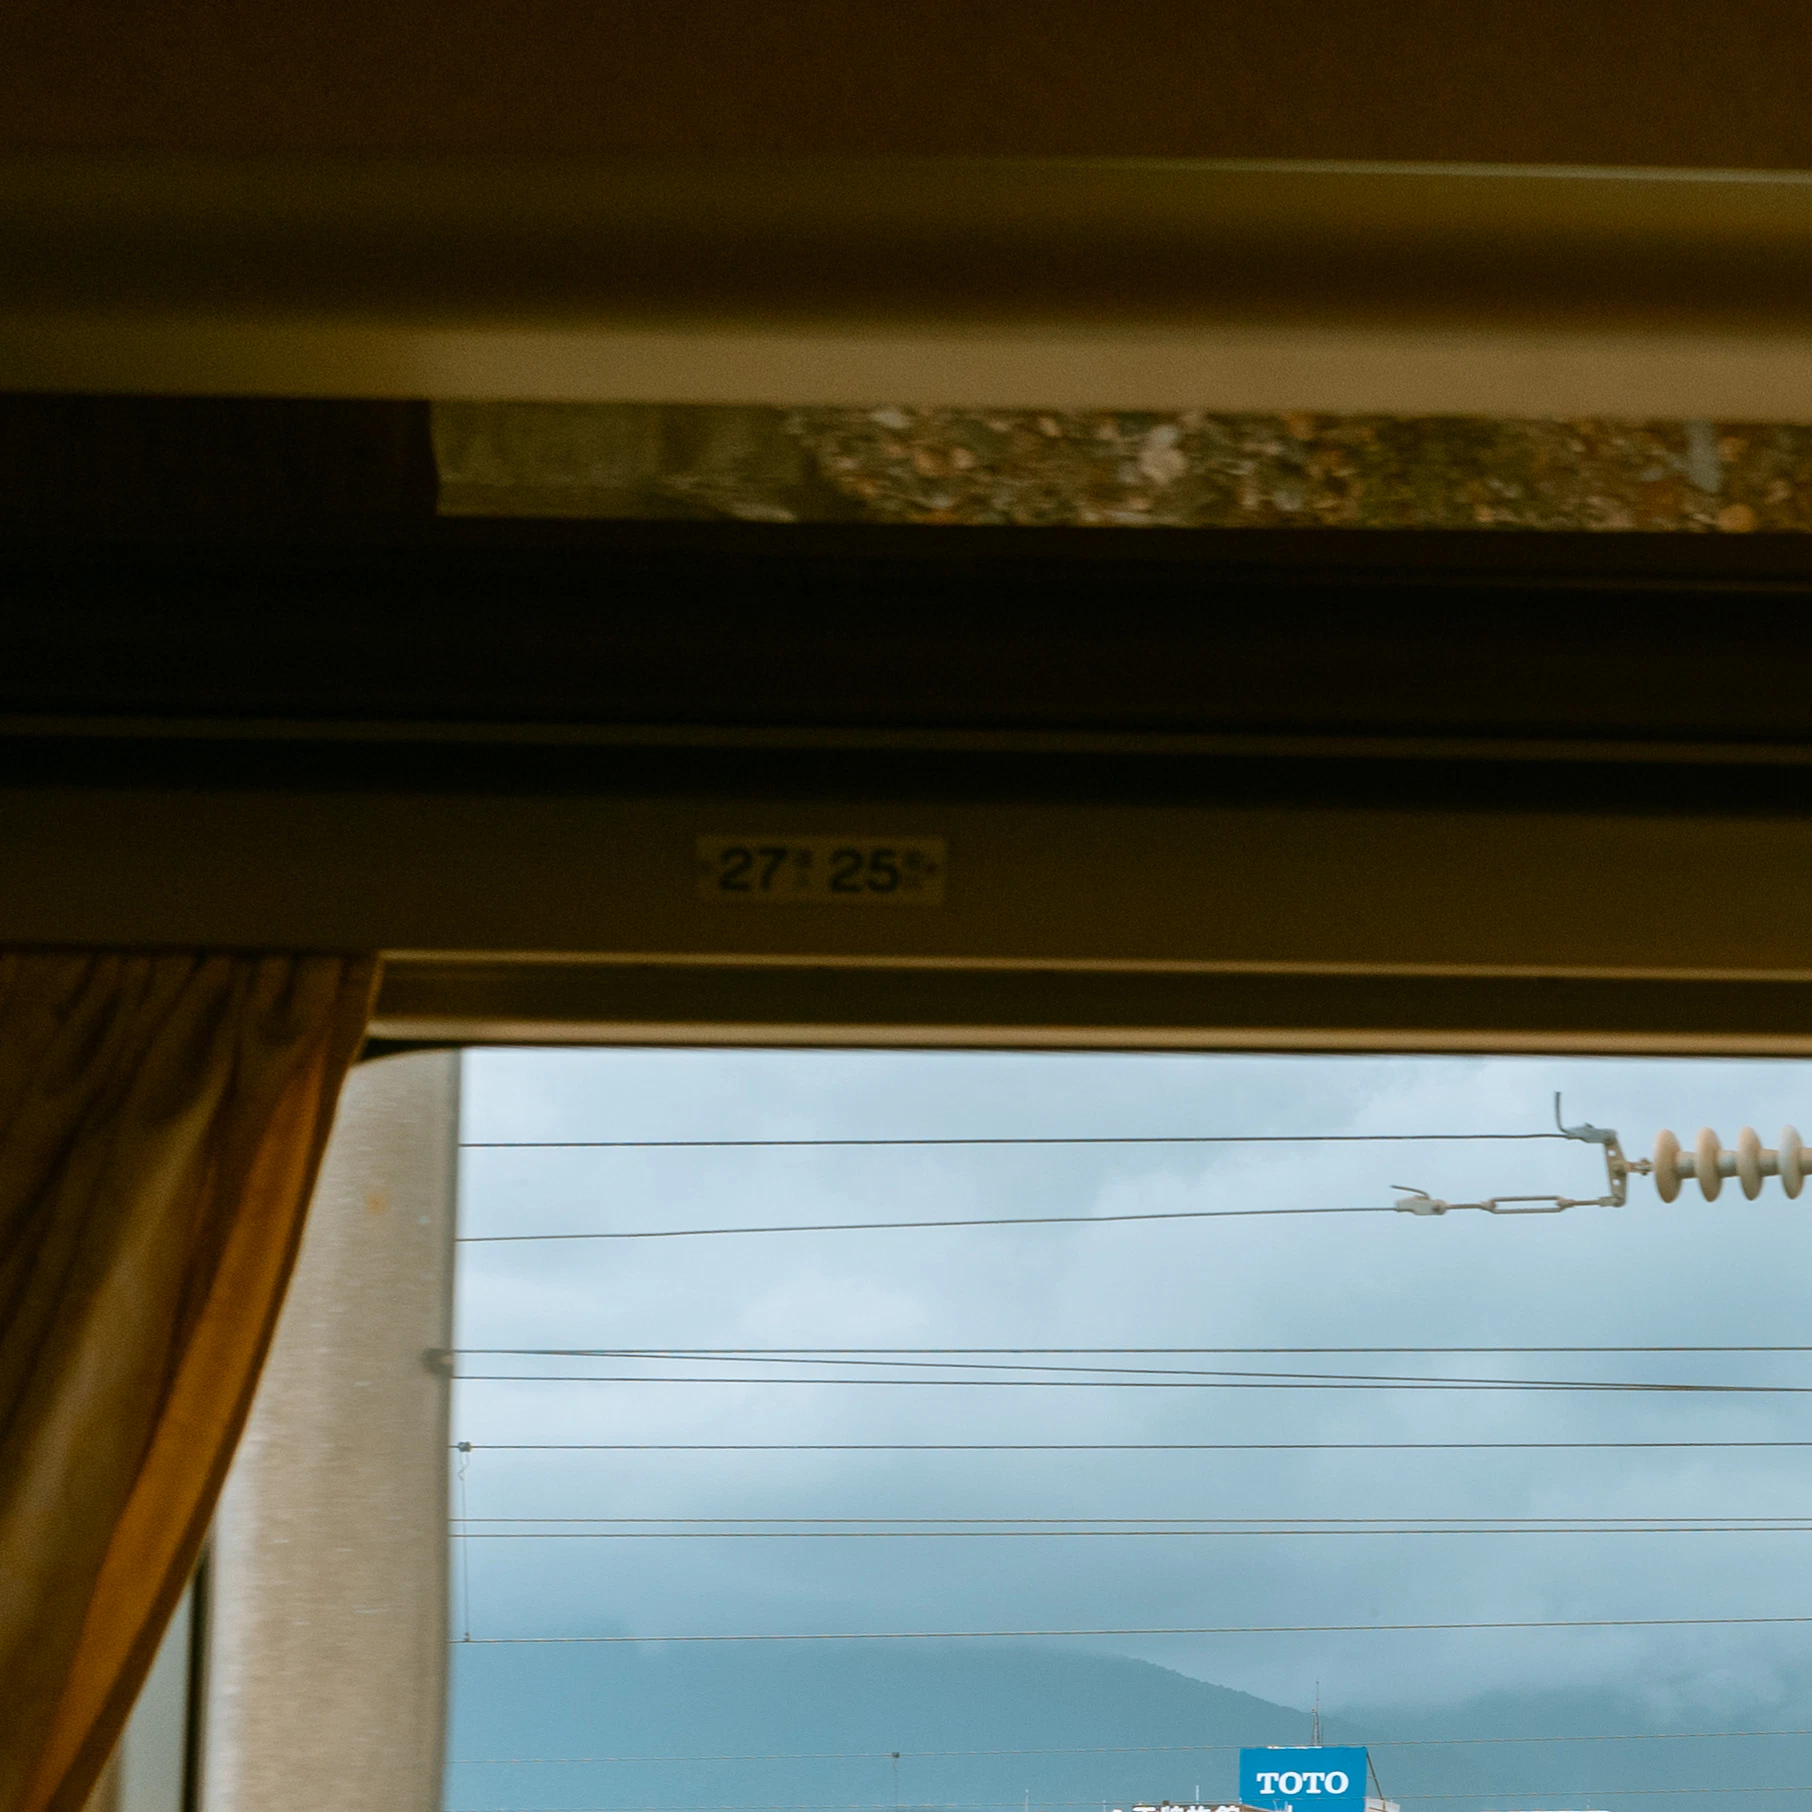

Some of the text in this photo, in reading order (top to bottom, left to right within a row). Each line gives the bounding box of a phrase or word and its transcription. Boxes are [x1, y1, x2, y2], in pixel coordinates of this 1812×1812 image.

[719, 847, 788, 891] 27
[830, 849, 901, 892] 25
[1256, 1771, 1350, 1795] TOTO
